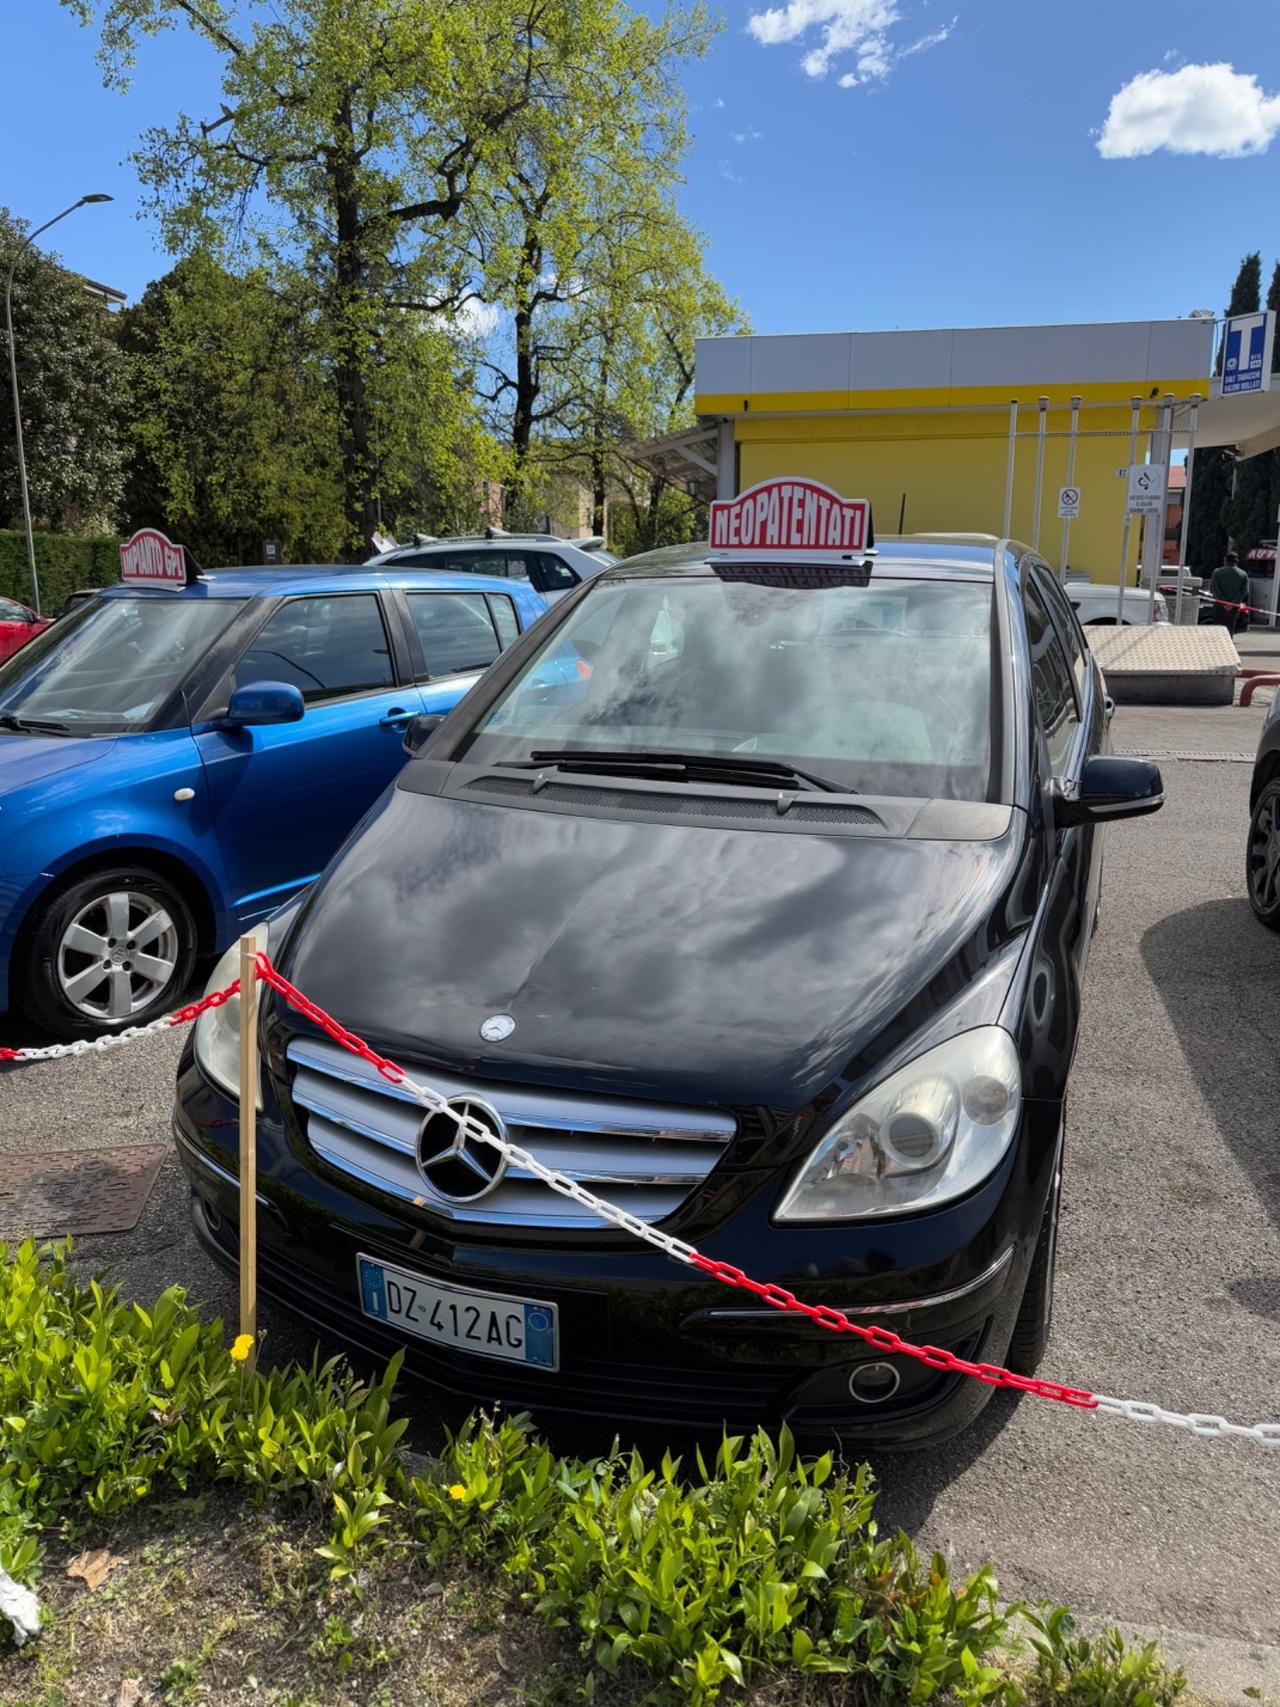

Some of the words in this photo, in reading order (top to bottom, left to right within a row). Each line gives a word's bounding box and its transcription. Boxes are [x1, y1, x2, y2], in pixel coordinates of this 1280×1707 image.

[1231, 315, 1264, 371] T
[1238, 371, 1260, 382] TABACCHI
[1241, 379, 1260, 390] BOLLATI
[715, 485, 862, 546] NEOPATENTATI
[122, 536, 163, 575] IMPIANTO
[164, 545, 183, 577] GPL
